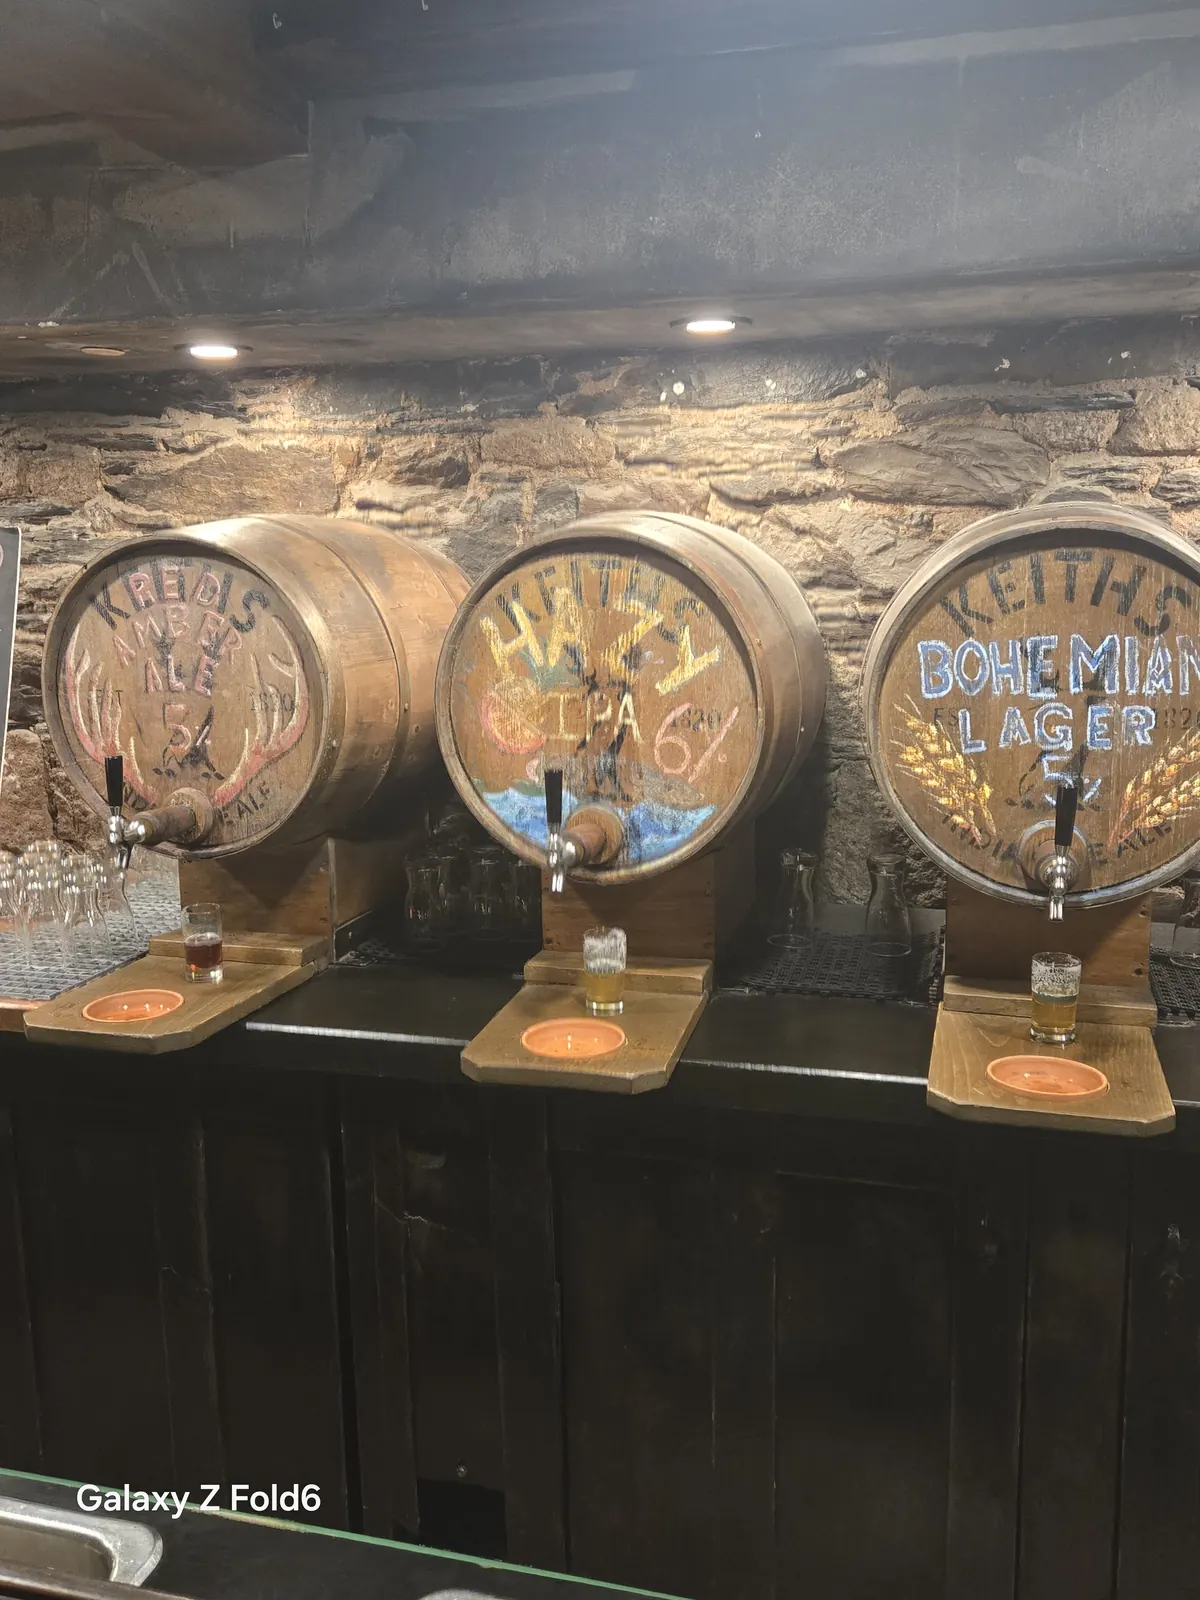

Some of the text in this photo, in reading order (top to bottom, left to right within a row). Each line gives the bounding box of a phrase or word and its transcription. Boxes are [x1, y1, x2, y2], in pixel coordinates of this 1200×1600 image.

[941, 552, 1192, 637] KEITHS
[480, 587, 721, 697] HAZY
[917, 633, 1200, 699] BOHEMIAN
[144, 654, 220, 697] ALE
[549, 692, 646, 746] IPA
[957, 702, 1156, 754] LAGER
